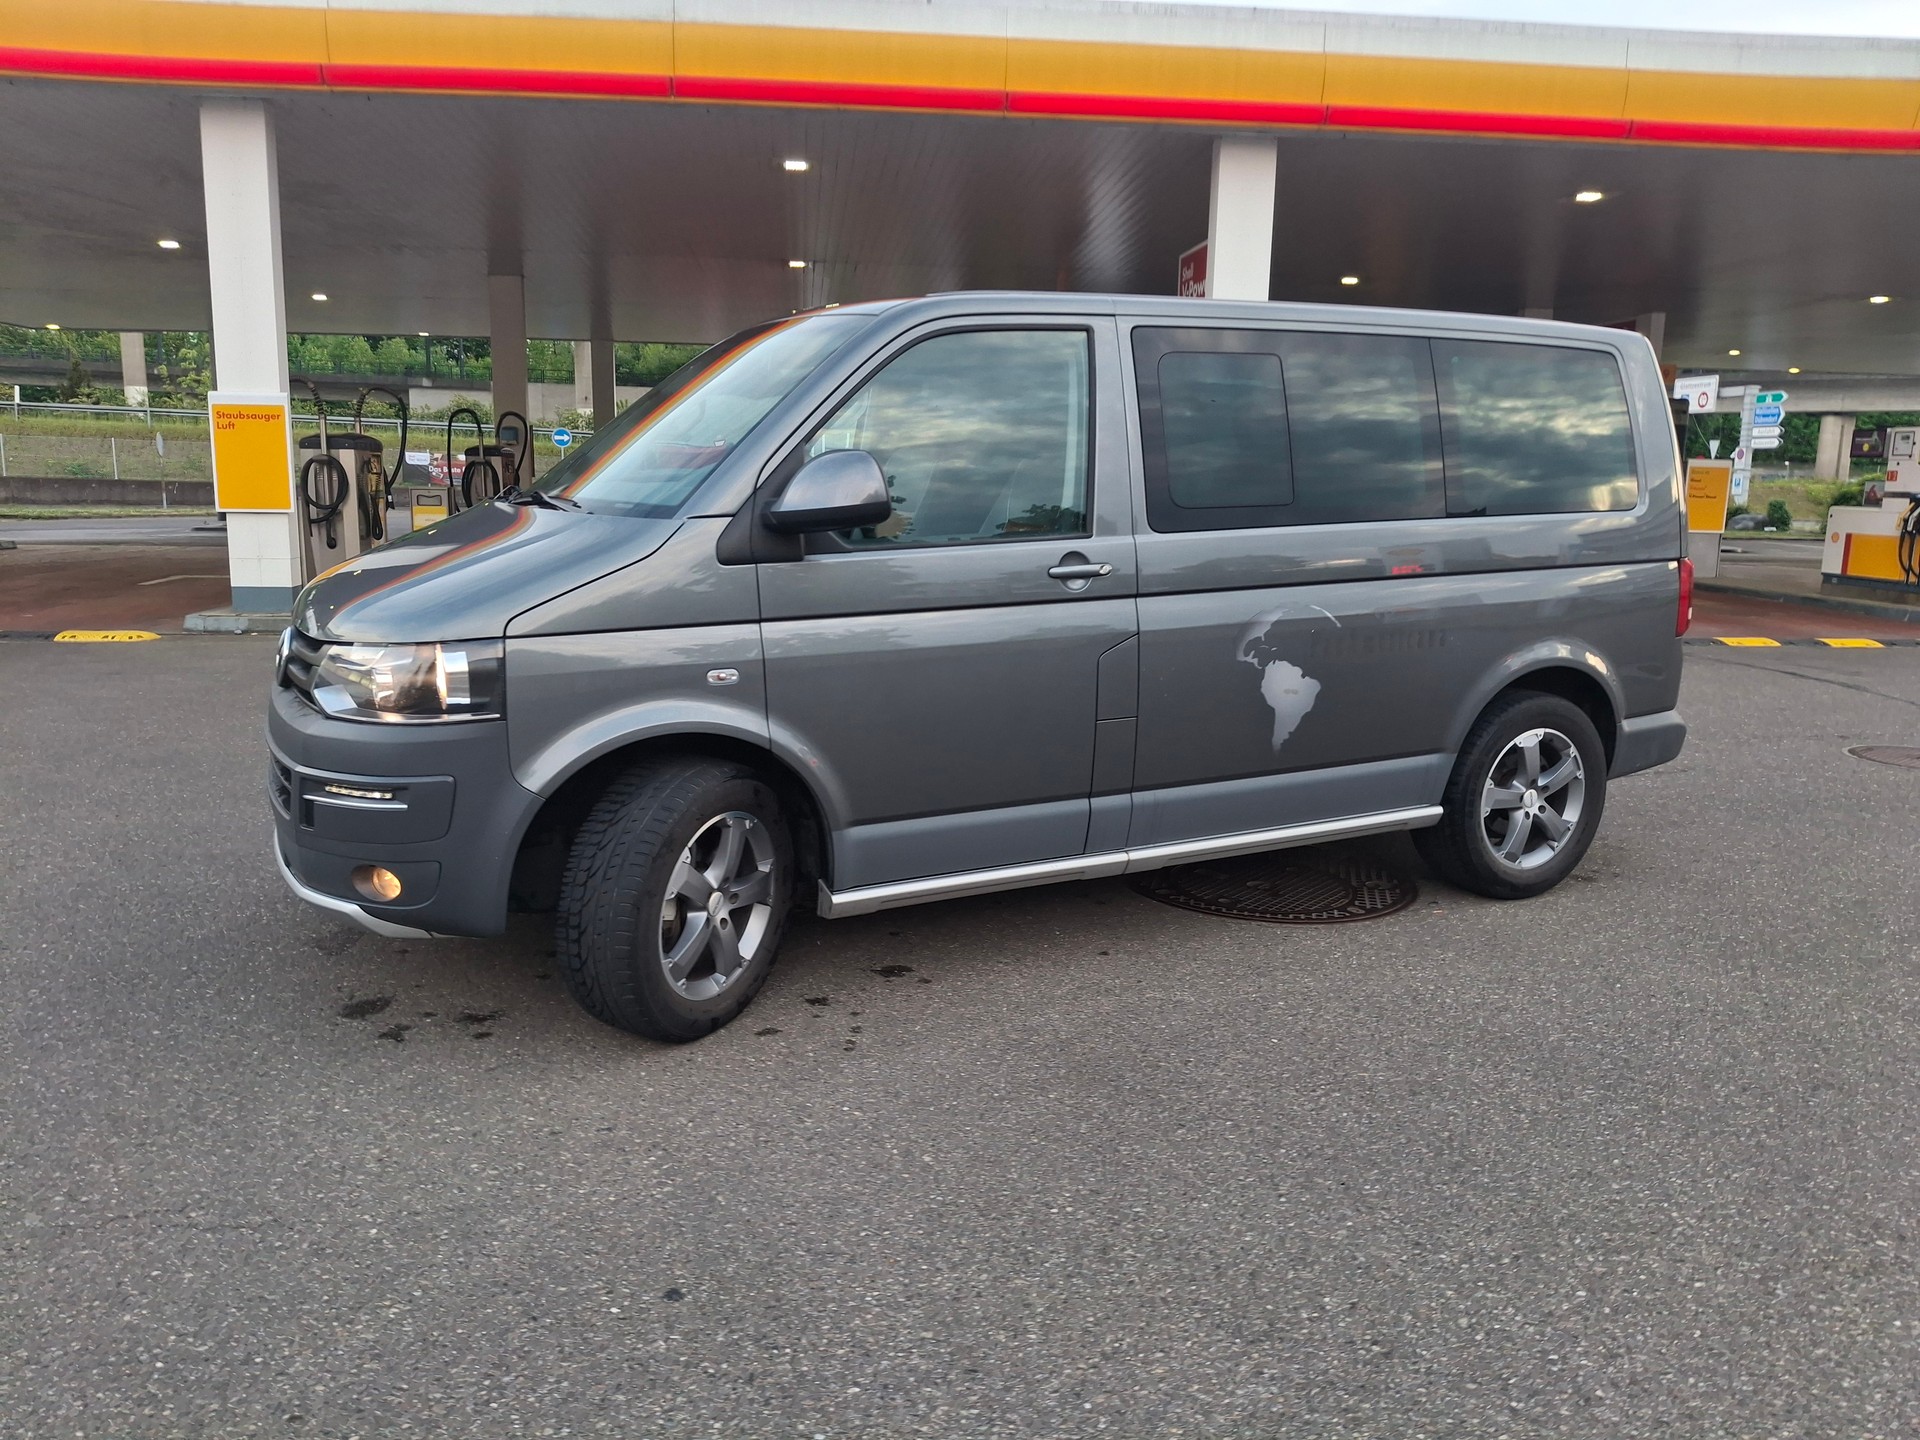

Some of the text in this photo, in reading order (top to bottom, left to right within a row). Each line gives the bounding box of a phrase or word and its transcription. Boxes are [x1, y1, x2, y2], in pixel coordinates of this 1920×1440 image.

[216, 411, 281, 422] Staubsauger
[217, 421, 235, 430] Luft
[428, 465, 442, 473] Das
